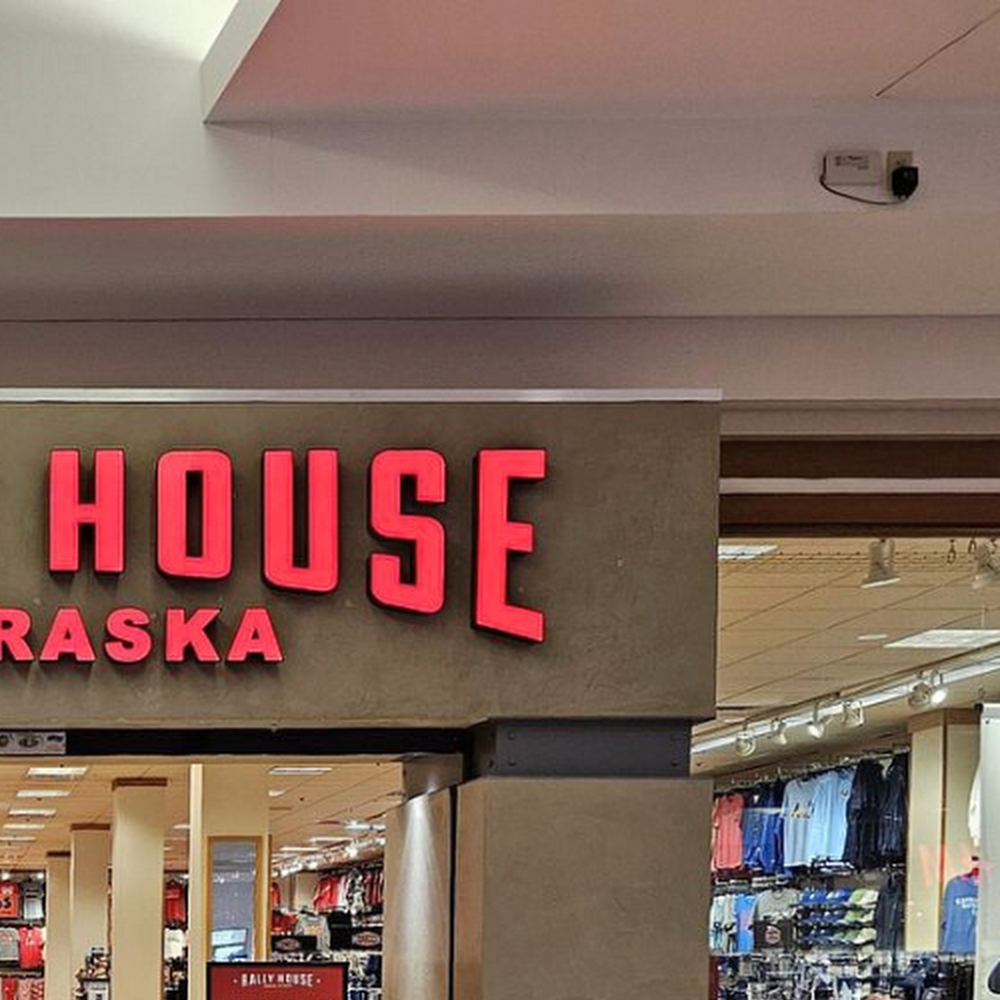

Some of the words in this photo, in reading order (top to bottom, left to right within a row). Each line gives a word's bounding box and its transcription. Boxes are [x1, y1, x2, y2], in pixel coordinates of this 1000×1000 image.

[47, 447, 548, 643] HOUSE
[241, 973, 275, 987] RALLY
[277, 973, 314, 987] HOUSE
